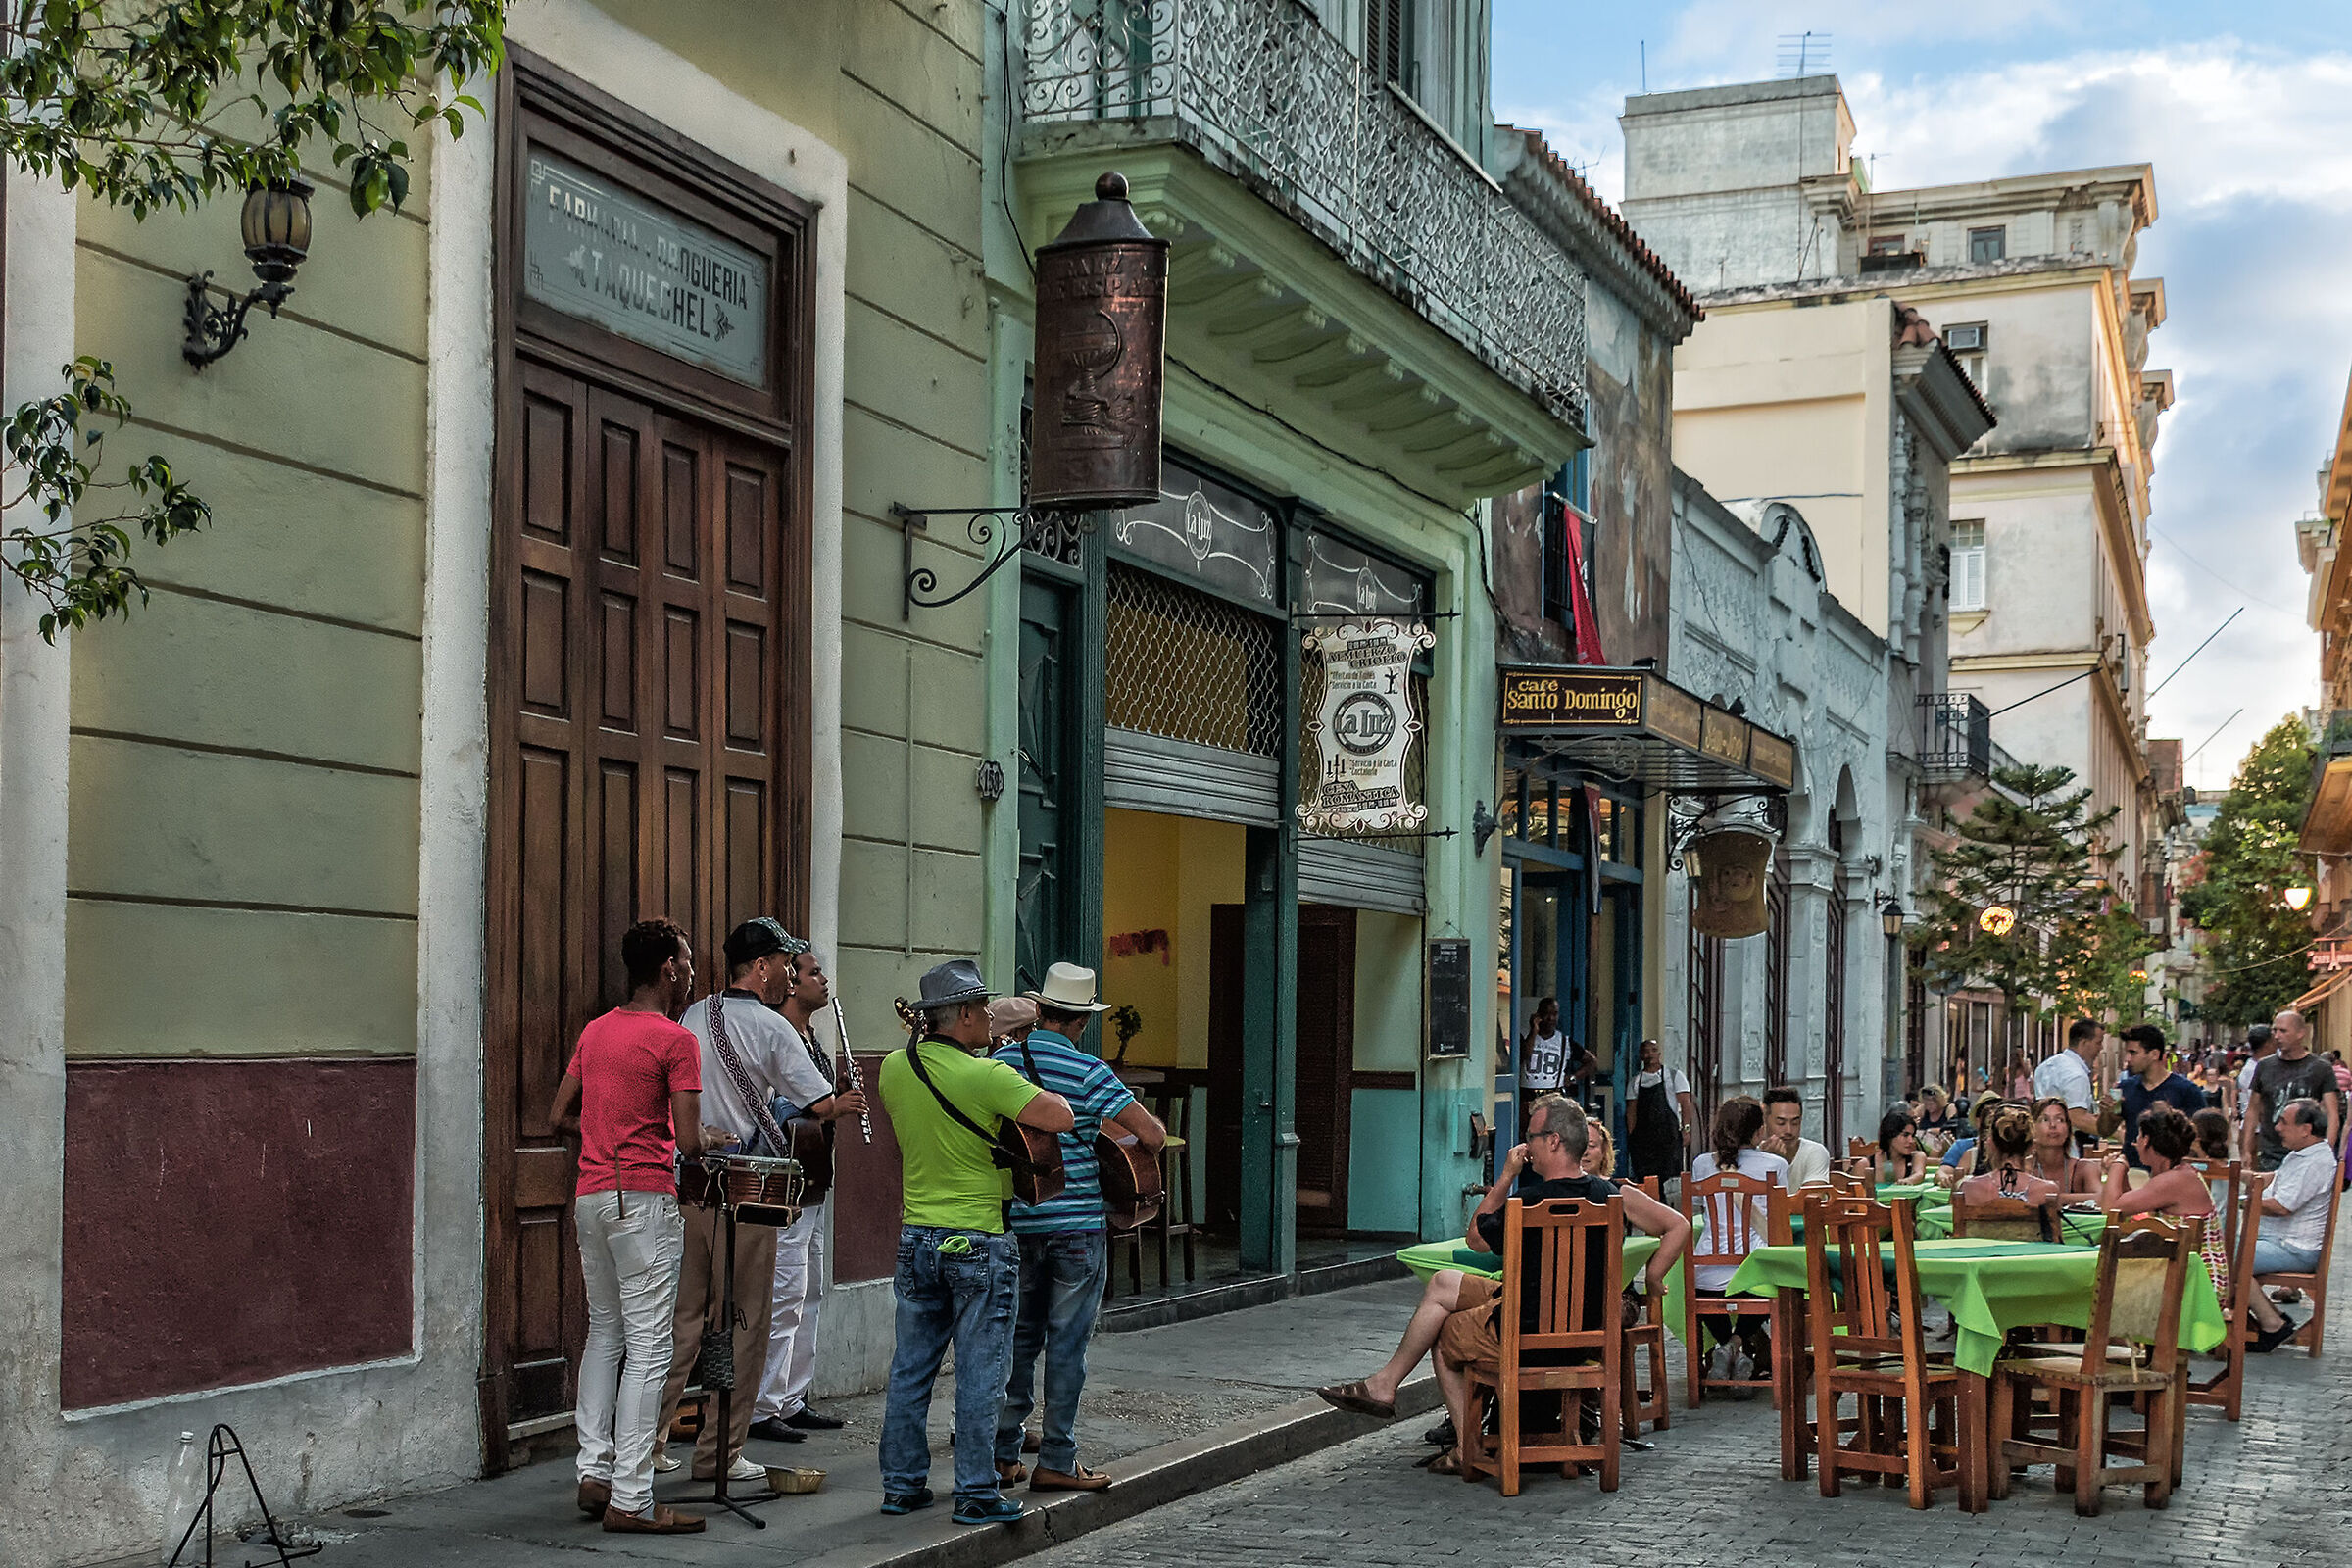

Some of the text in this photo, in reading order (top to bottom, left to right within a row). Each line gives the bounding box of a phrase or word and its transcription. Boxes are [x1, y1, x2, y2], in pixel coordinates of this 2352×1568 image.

[656, 234, 748, 311] DROGUERIA
[591, 250, 710, 339] TAQUECHEL
[1329, 644, 1396, 662] ALMUERZO
[1349, 651, 1406, 668] CRIOLLO
[1518, 679, 1559, 692] café
[1507, 687, 1638, 719] Santo Domingo
[1334, 709, 1393, 738] La Luz
[1324, 782, 1357, 795] CENA
[1526, 1050, 1560, 1075] 08
